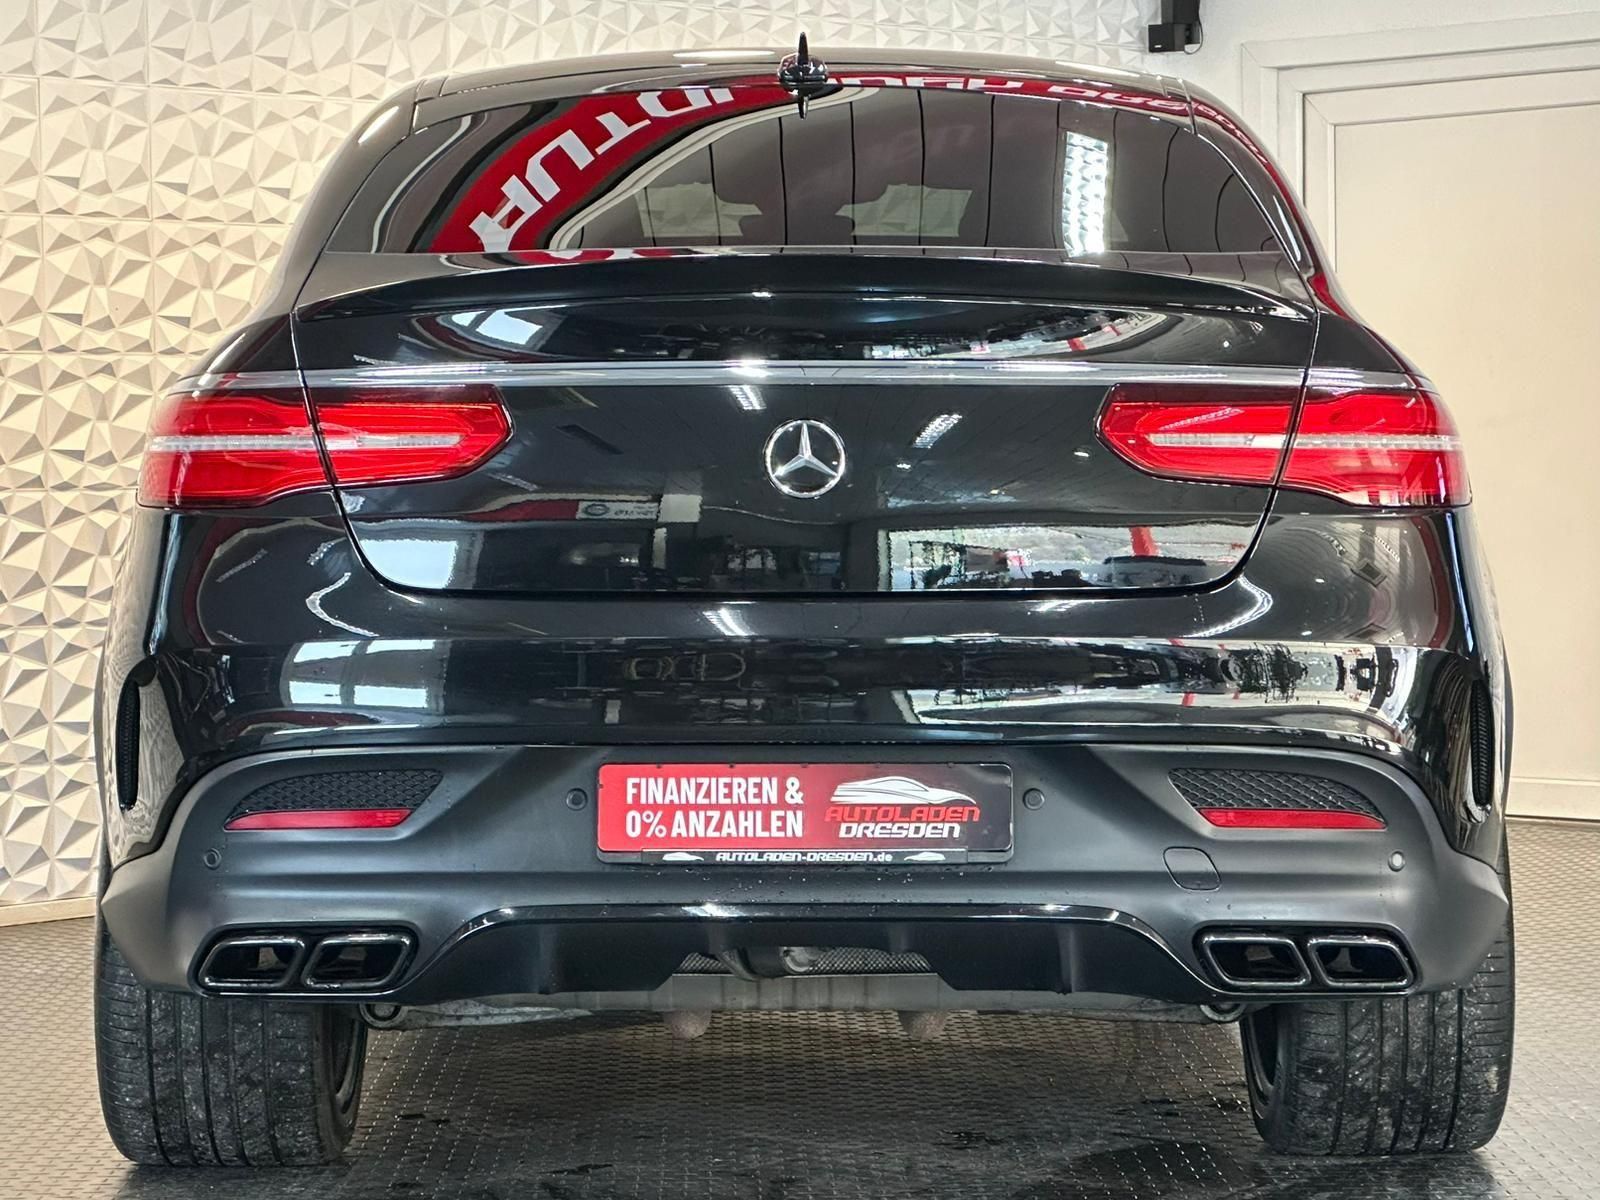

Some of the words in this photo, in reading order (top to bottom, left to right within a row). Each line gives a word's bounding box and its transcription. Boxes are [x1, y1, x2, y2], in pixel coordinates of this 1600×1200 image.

[626, 777, 777, 804] FINANZIEREN
[785, 777, 804, 805] &
[626, 811, 666, 838] 0%
[671, 811, 803, 838] ANZAHLEN
[824, 806, 980, 822] AUTOLADEN
[839, 823, 960, 838] DRESDEN
